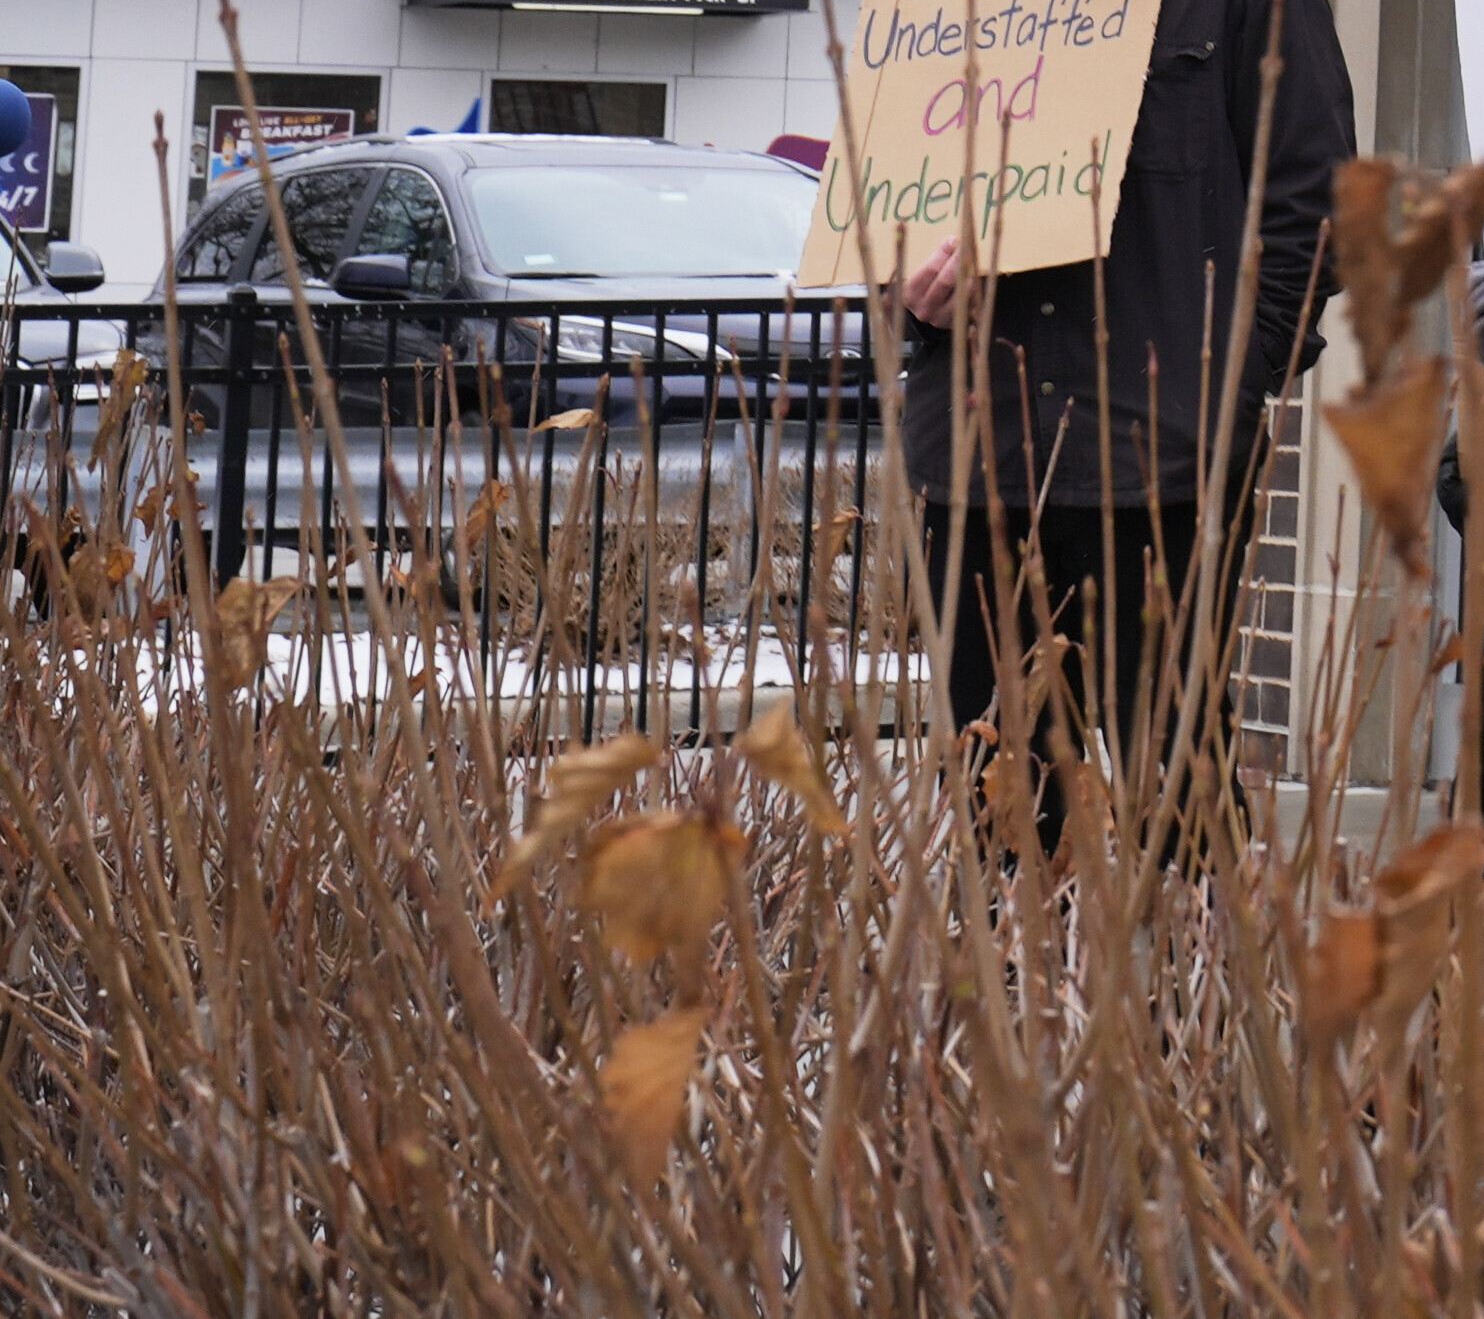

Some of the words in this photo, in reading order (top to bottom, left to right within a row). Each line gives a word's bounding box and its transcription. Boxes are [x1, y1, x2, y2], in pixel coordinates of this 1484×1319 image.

[240, 124, 334, 139] BEAKFAST
[923, 54, 1044, 136] and
[826, 128, 1111, 240] Underpaid
